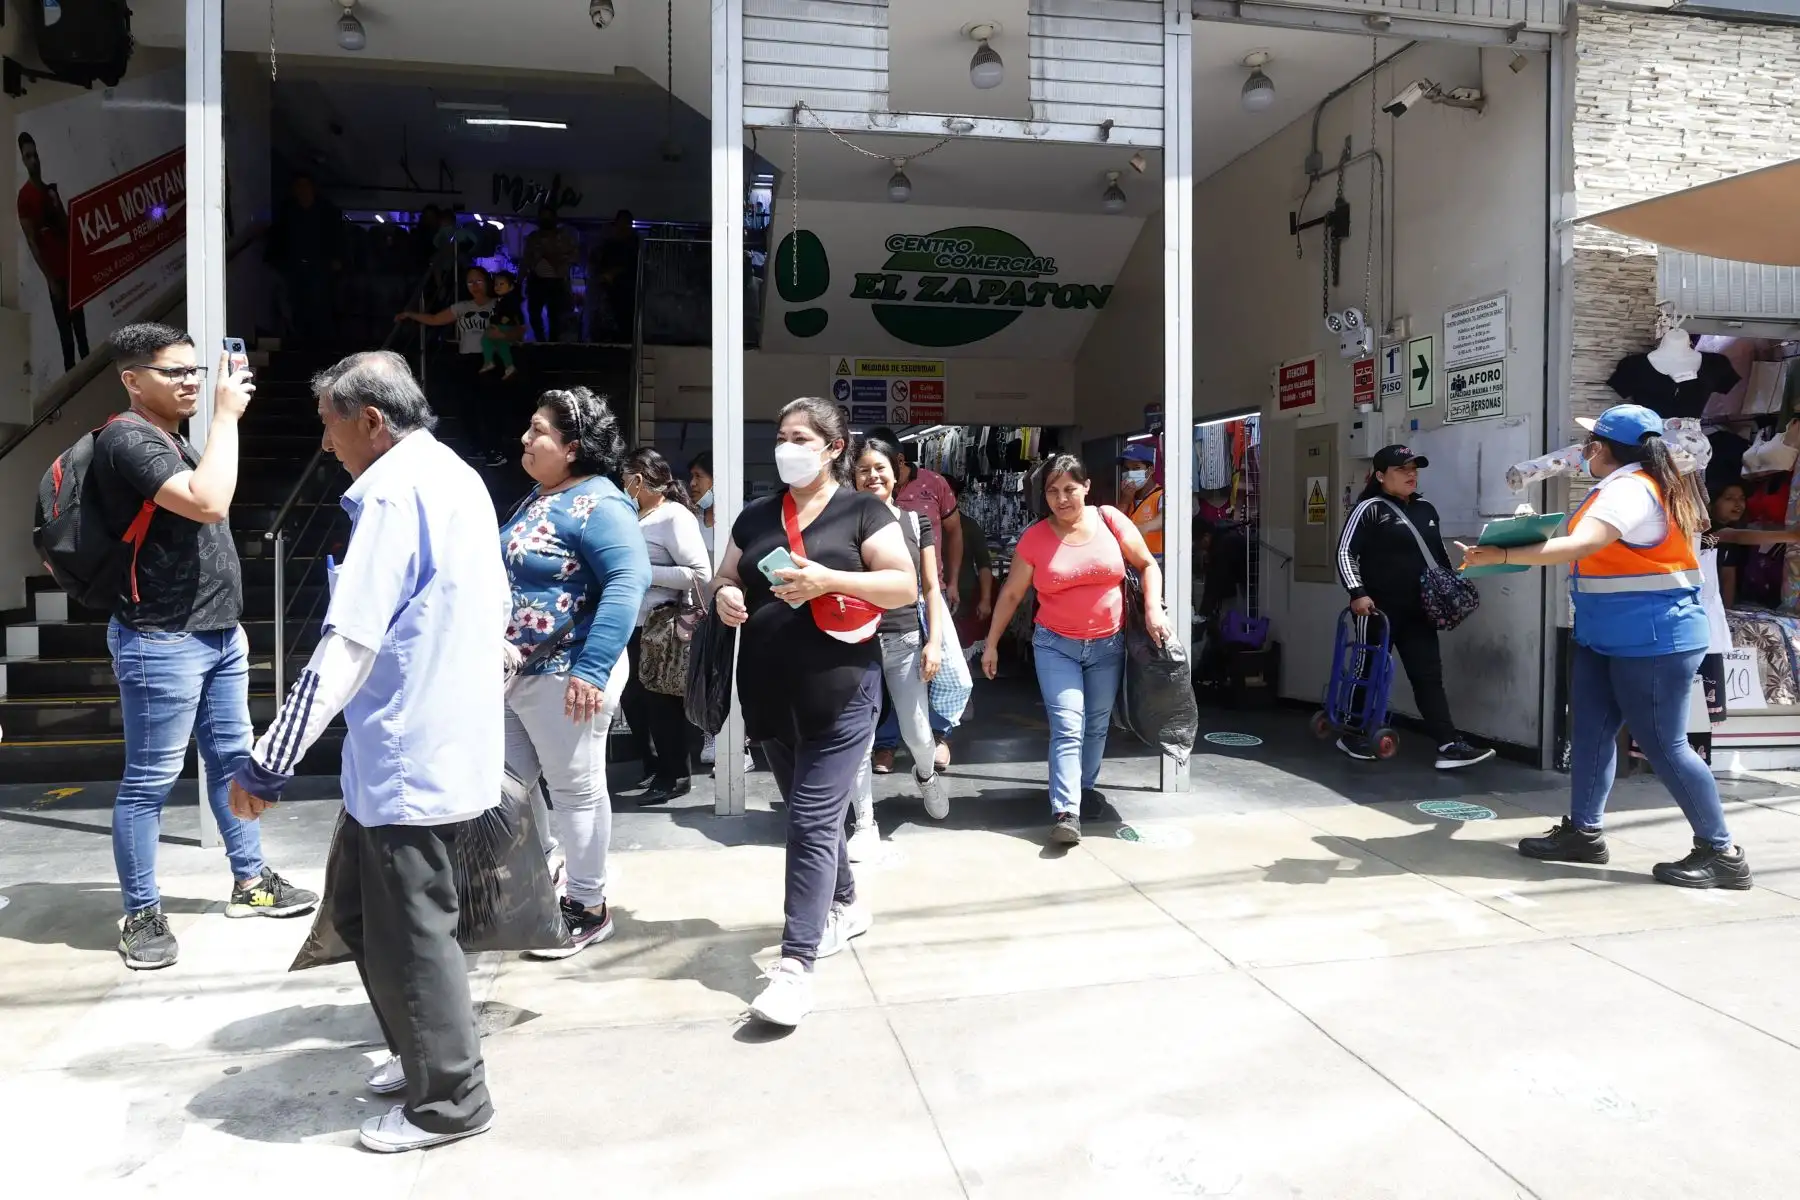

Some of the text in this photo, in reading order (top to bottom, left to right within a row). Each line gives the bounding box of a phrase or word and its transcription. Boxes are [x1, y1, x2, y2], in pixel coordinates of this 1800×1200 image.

[78, 203, 120, 246] KAL
[887, 235, 974, 254] CENTRO
[935, 253, 1057, 274] COMERCIAL
[850, 272, 1114, 309] EL ZAPATON
[861, 363, 889, 373] MEDIDAS
[900, 364, 936, 374] SEGURIDAD
[1468, 368, 1501, 386] AFORO
[1381, 381, 1401, 393] PISO
[1471, 396, 1501, 412] PERSONAS
[1726, 668, 1750, 702] 10
